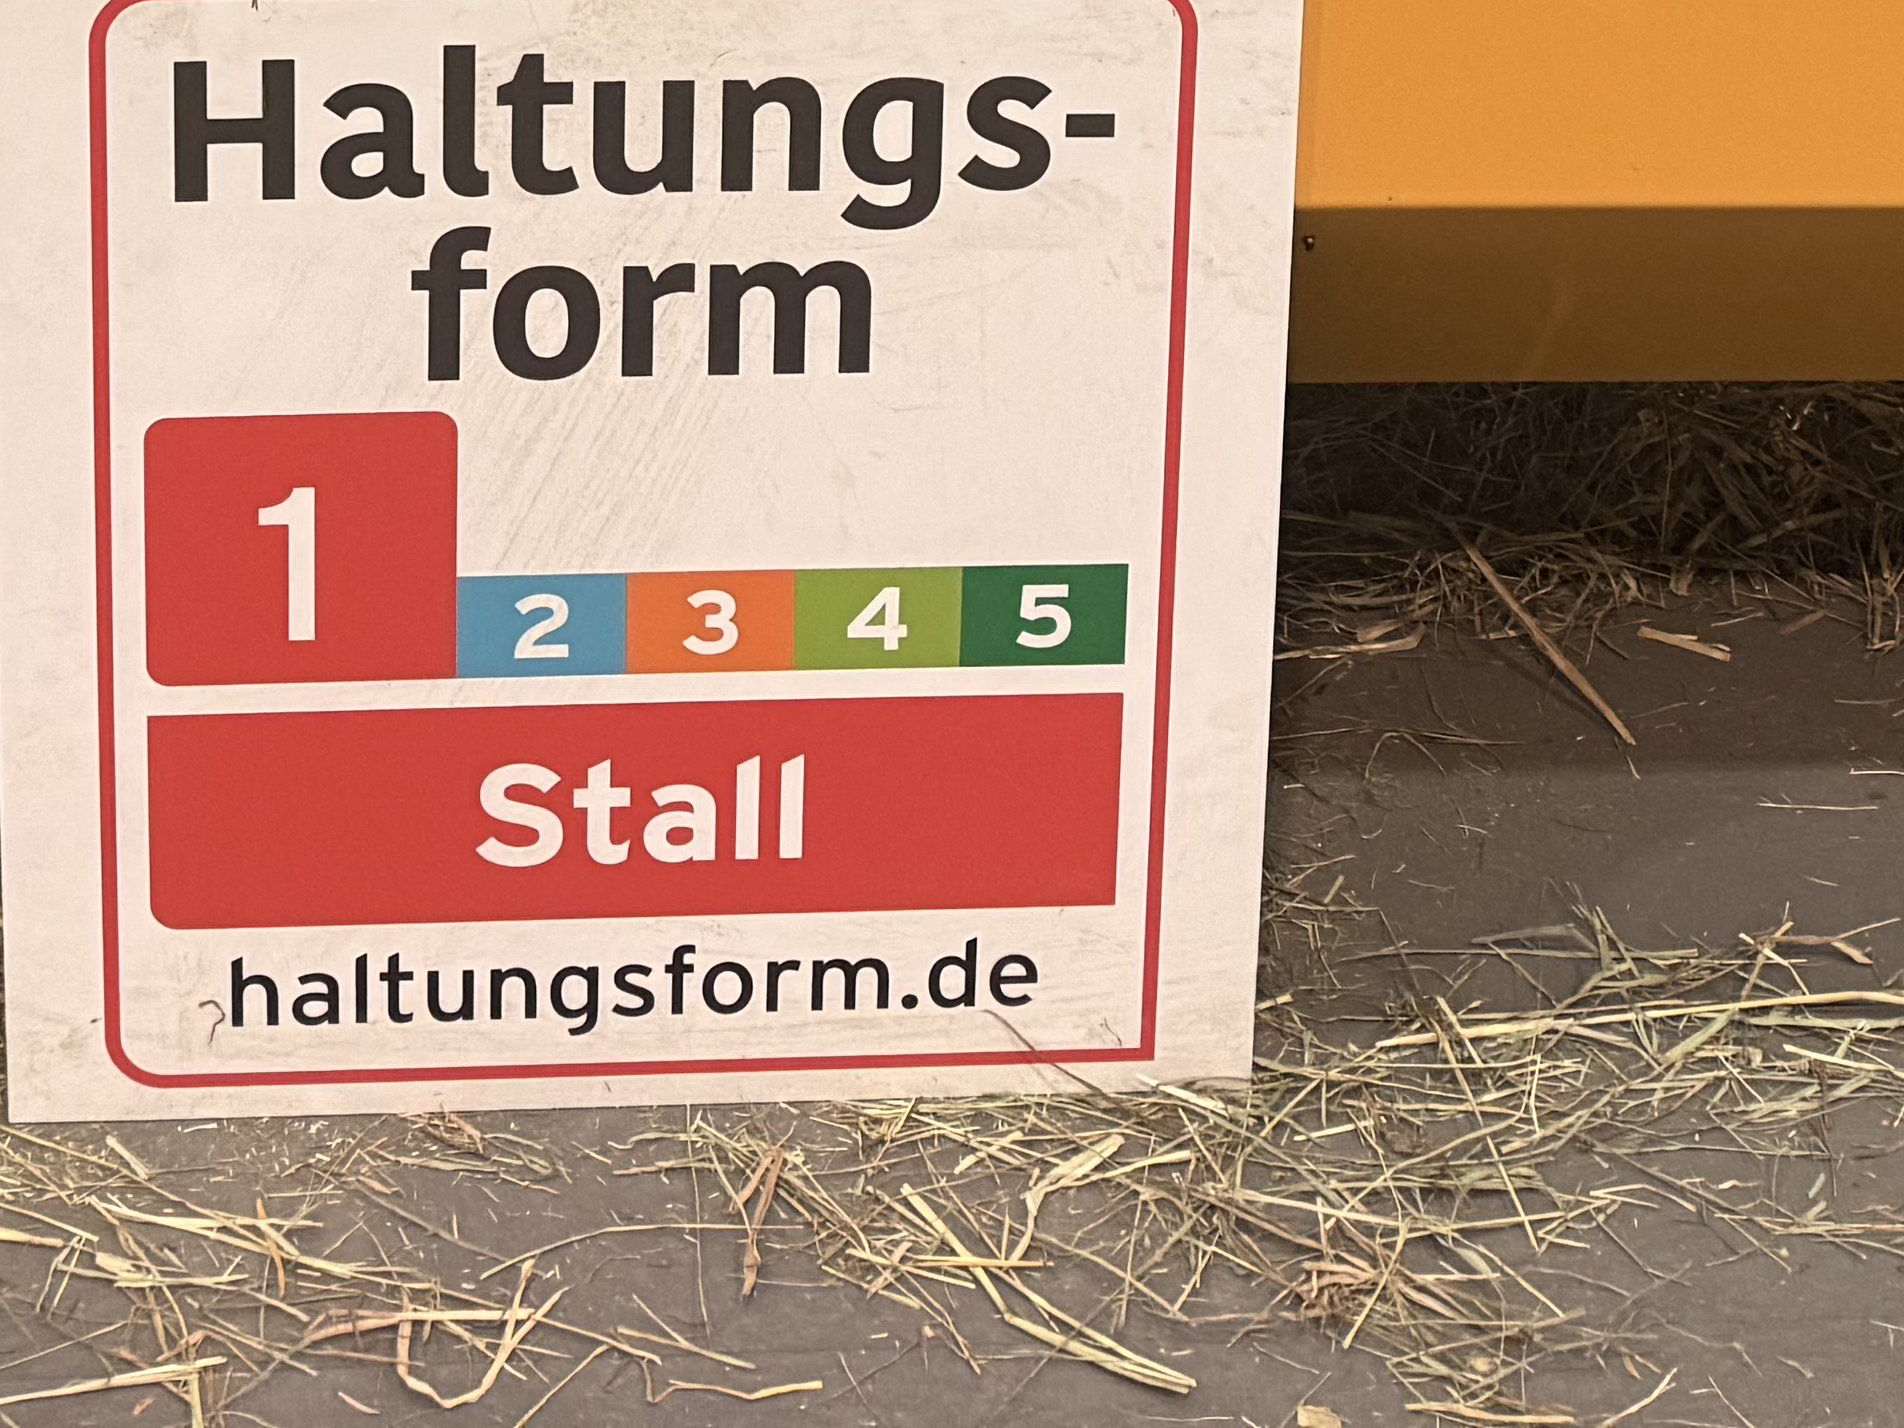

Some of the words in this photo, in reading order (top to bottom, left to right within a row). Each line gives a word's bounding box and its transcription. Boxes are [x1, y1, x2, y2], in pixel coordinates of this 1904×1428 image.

[170, 43, 1118, 231] Haltungs-
[410, 224, 876, 383] form
[256, 486, 317, 644] 1
[511, 593, 572, 660] 2
[682, 589, 740, 656] 3
[845, 586, 909, 653] 4
[1013, 583, 1073, 650] 5
[474, 752, 807, 868] Stall
[226, 938, 1041, 1035] haltungsform.de
